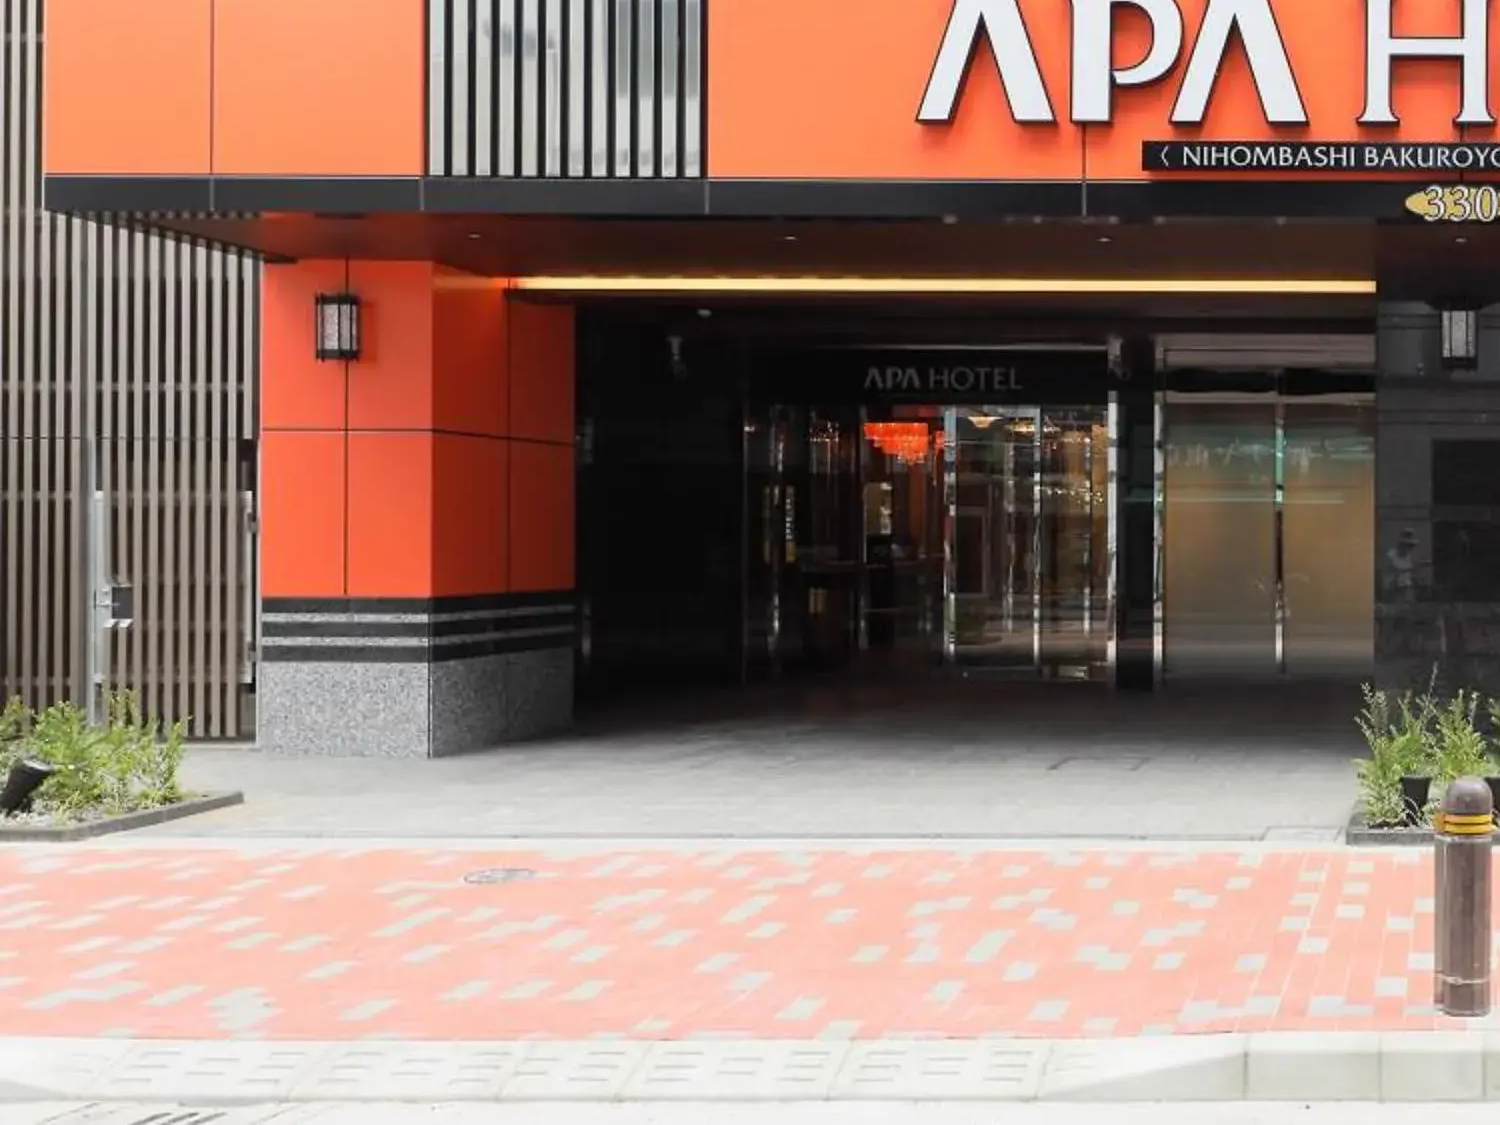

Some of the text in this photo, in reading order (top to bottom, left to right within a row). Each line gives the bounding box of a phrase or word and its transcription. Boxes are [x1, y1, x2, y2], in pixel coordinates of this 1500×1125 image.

[1182, 144, 1356, 167] NIHOMBASHI
[1423, 184, 1500, 223] 330
[863, 365, 1024, 391] APA HOTEL
